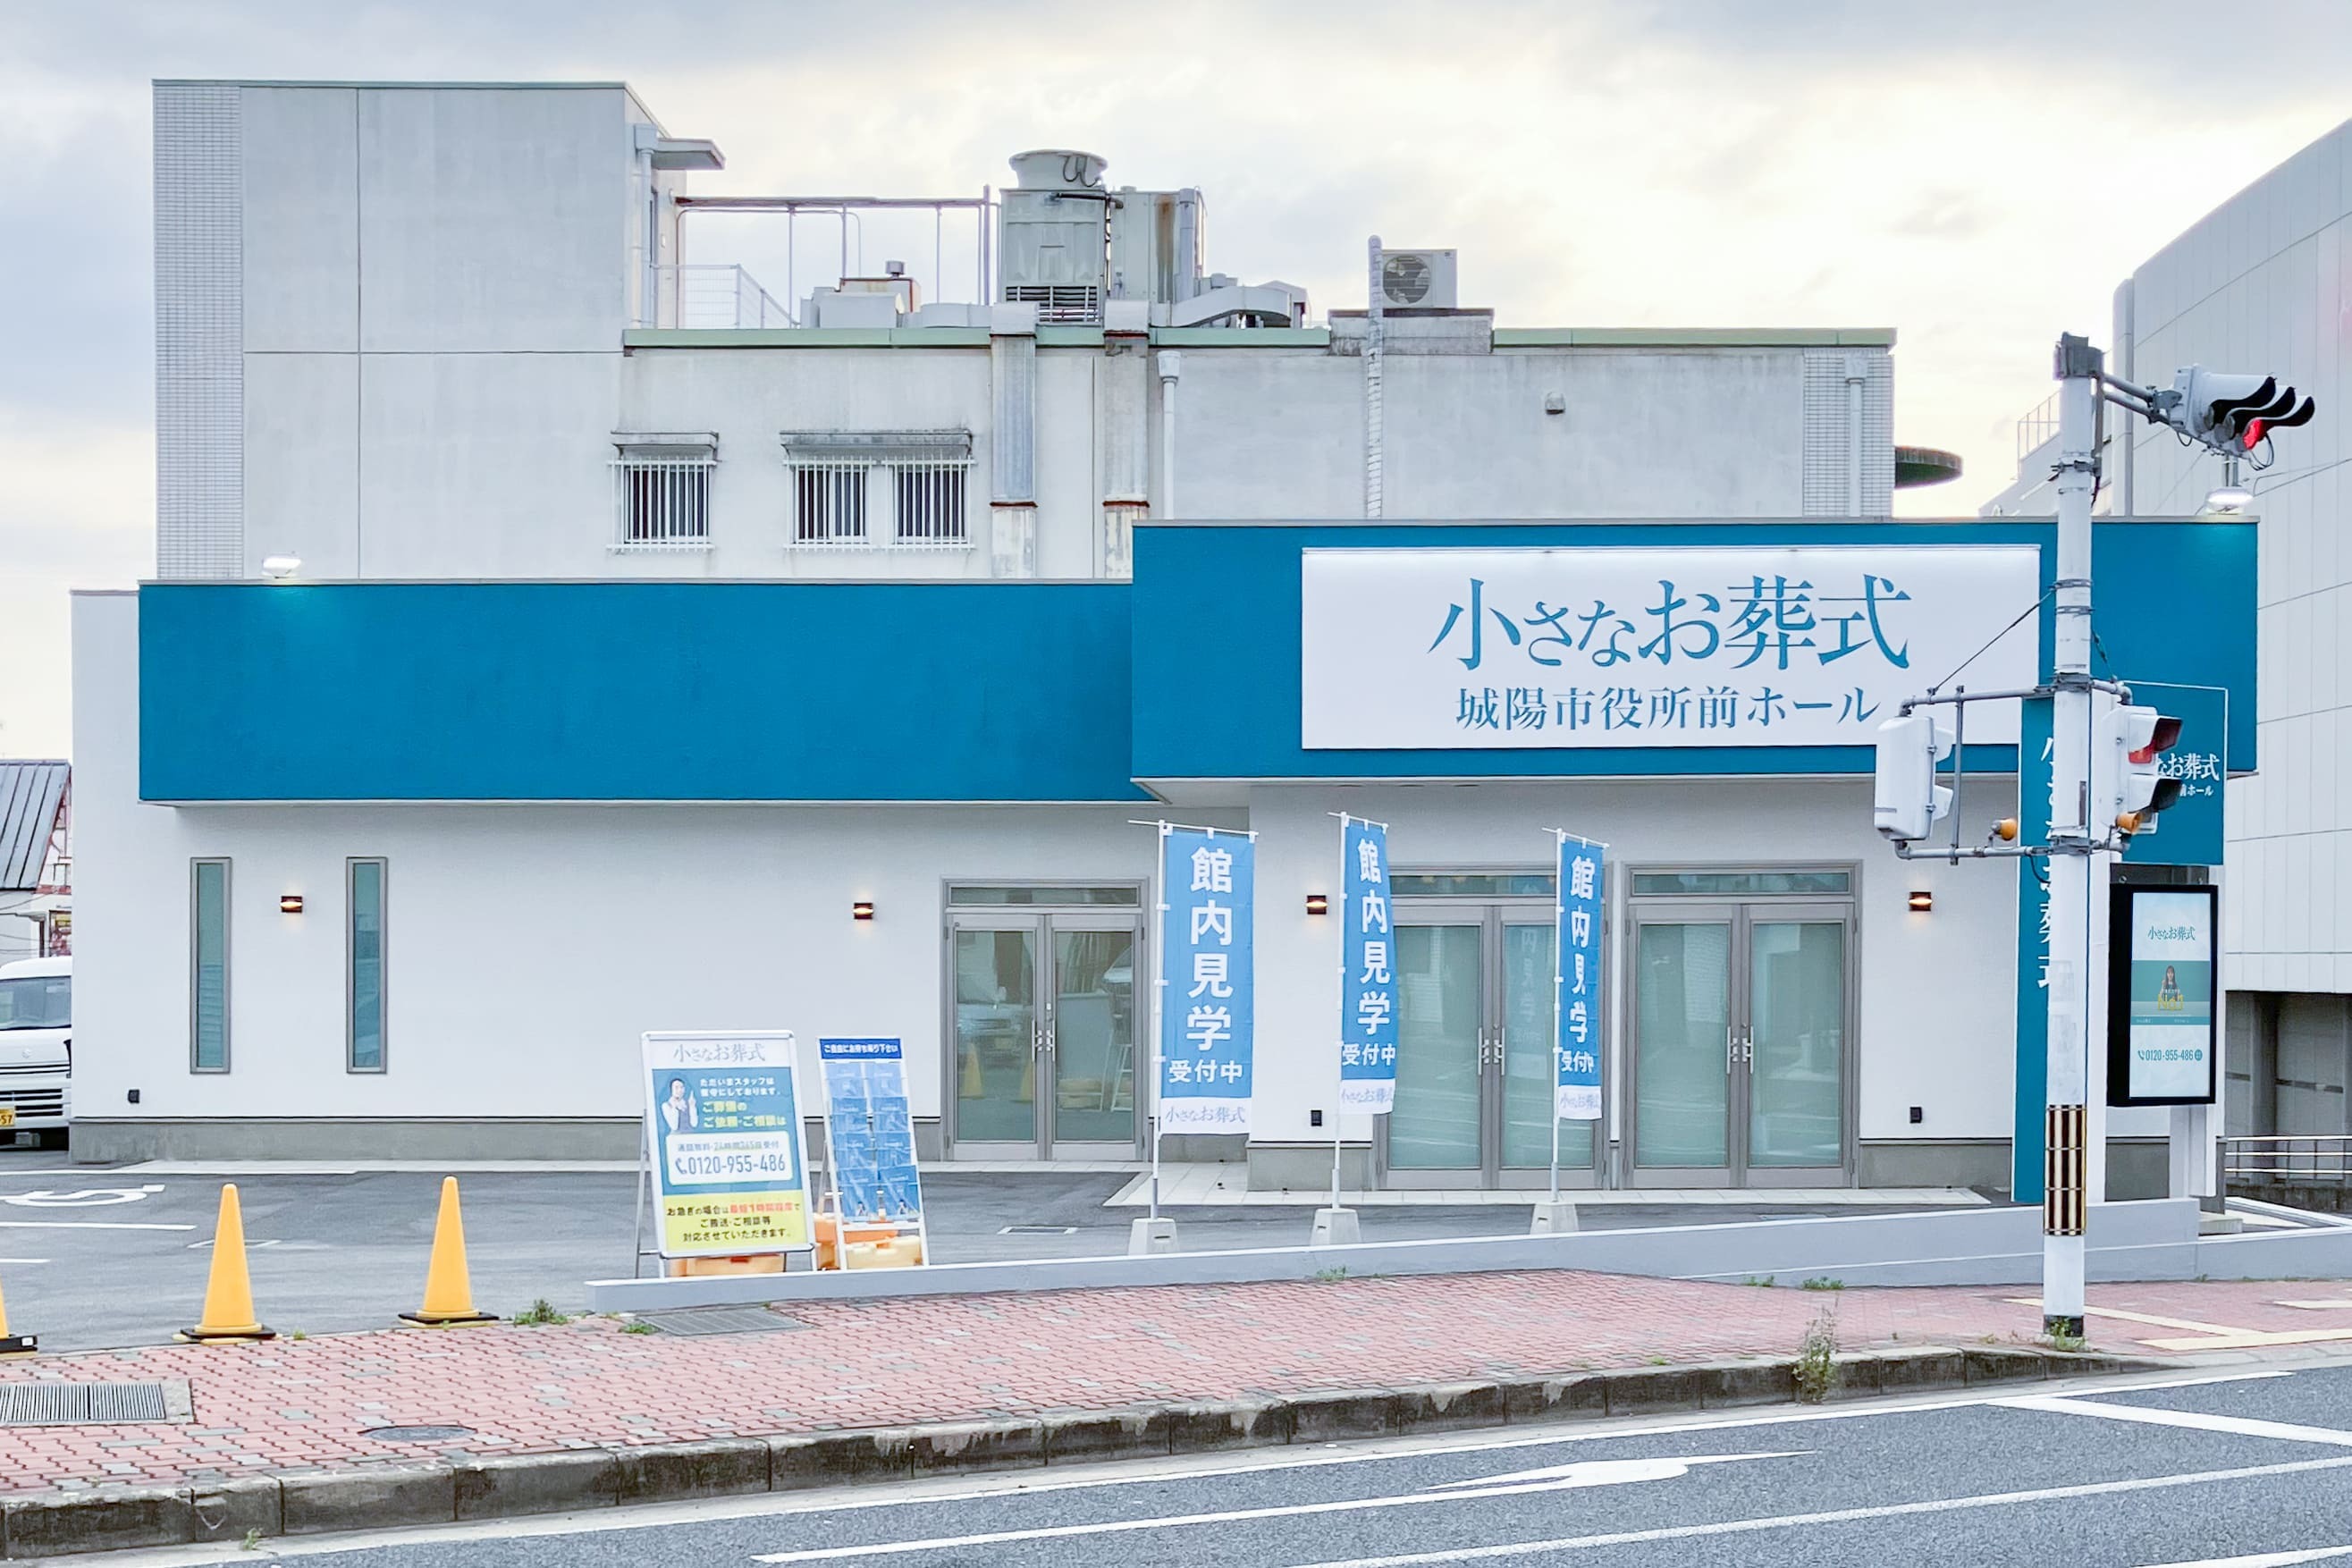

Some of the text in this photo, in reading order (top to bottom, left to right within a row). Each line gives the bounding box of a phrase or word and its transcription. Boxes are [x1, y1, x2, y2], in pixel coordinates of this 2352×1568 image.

[1428, 573, 1911, 670] 小さなお葬式
[1454, 687, 1881, 730] 城陽市役所前ホール
[2155, 753, 2220, 780] なお葬式
[1358, 839, 1390, 1035] 館内見学
[2147, 925, 2196, 940] 小さなお葬式
[1185, 847, 1233, 1051] 館内見学
[1570, 856, 1596, 1043] 館内見学
[673, 1043, 766, 1063] 小さなお葬式
[1342, 1043, 1395, 1066] 受付中
[1168, 1059, 1243, 1083] 受付中
[1166, 1106, 1245, 1123] 小さなお葬式
[687, 1153, 786, 1175] 0120-955-486
